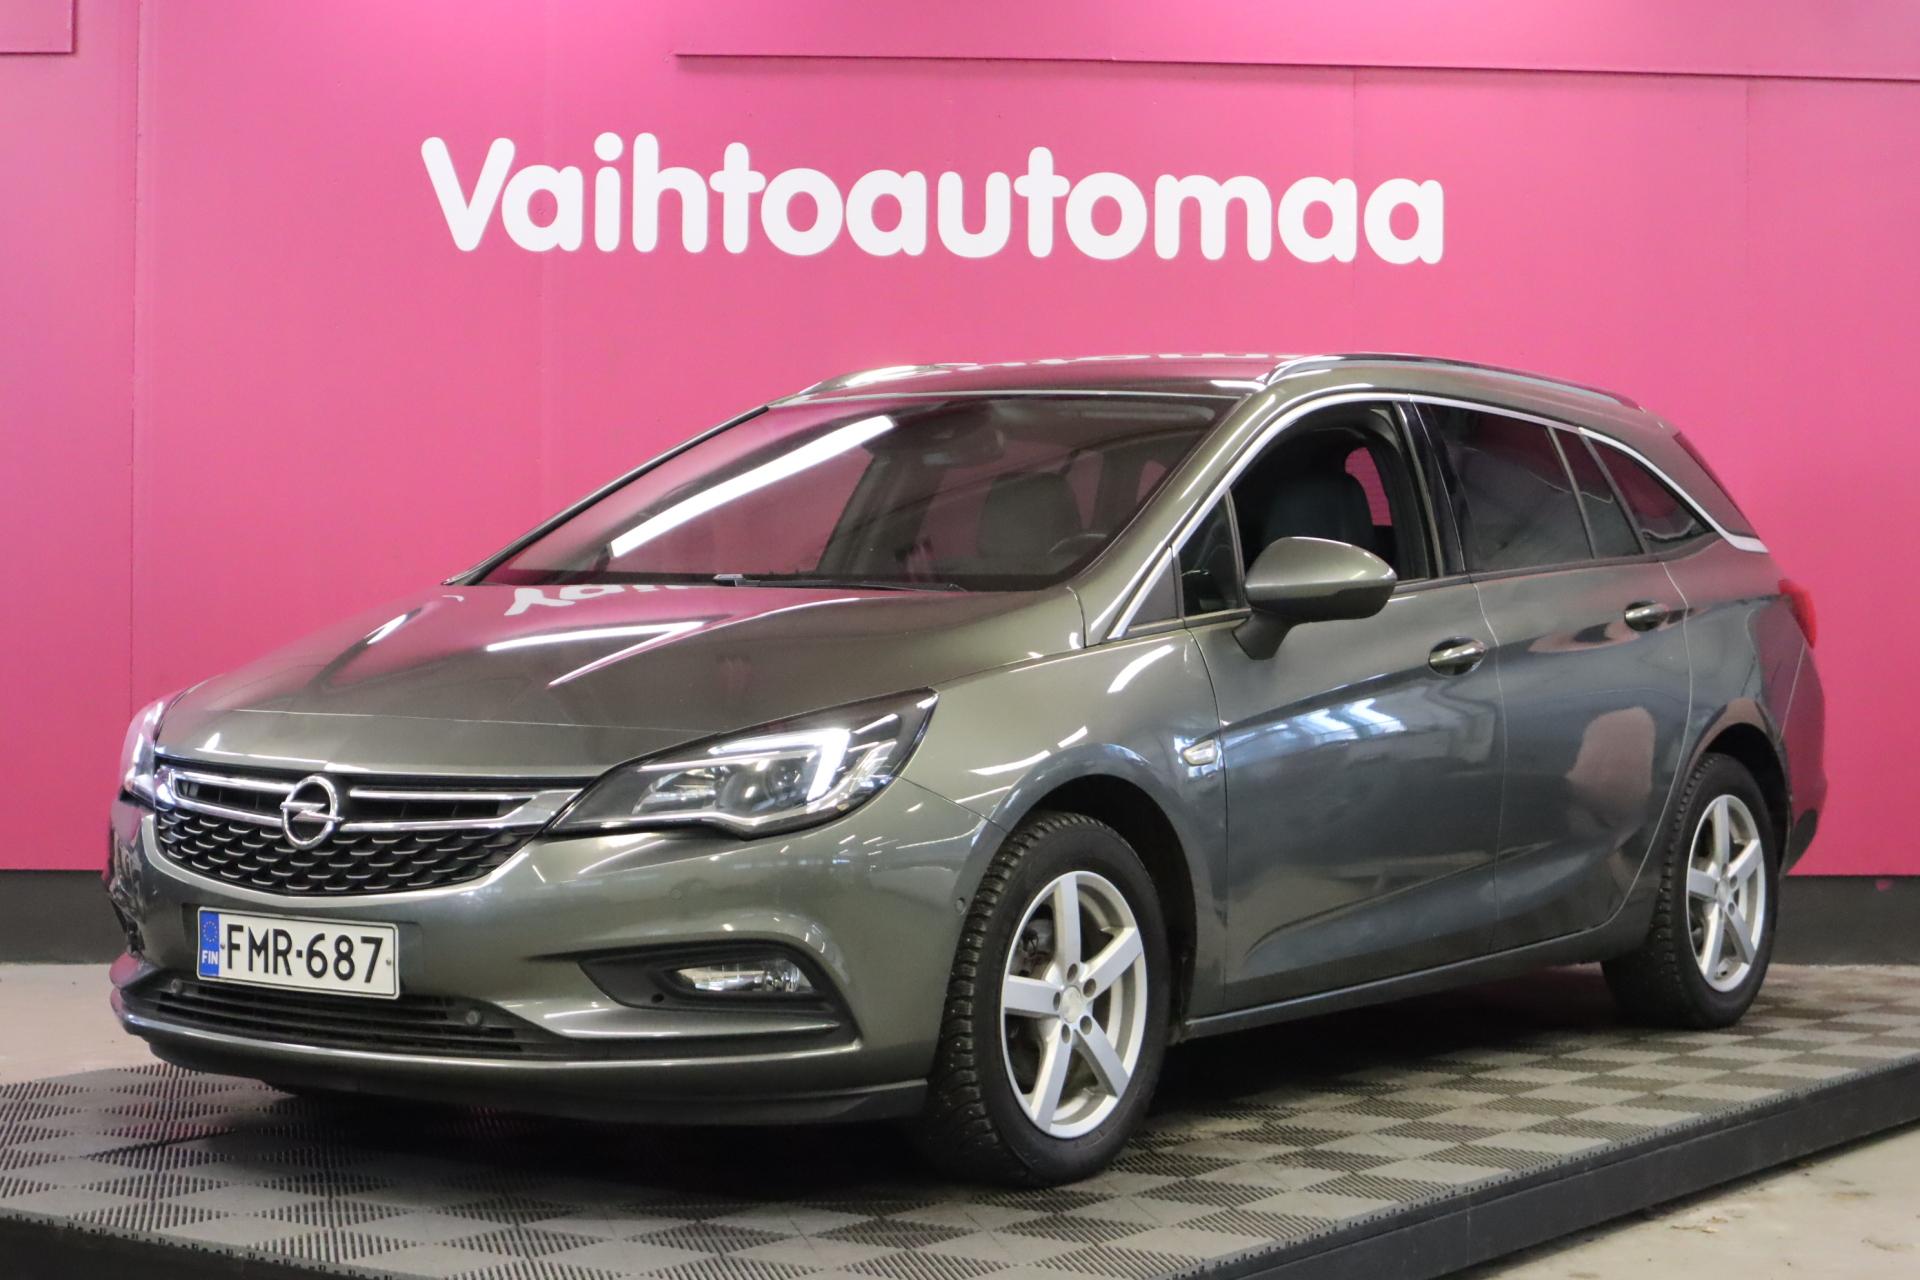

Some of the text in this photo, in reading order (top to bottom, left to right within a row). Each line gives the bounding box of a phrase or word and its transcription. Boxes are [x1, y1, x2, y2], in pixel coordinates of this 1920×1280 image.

[421, 132, 1444, 265] Vaihtoautomaa
[201, 950, 219, 966] FIN
[226, 923, 384, 983] FMR-687
